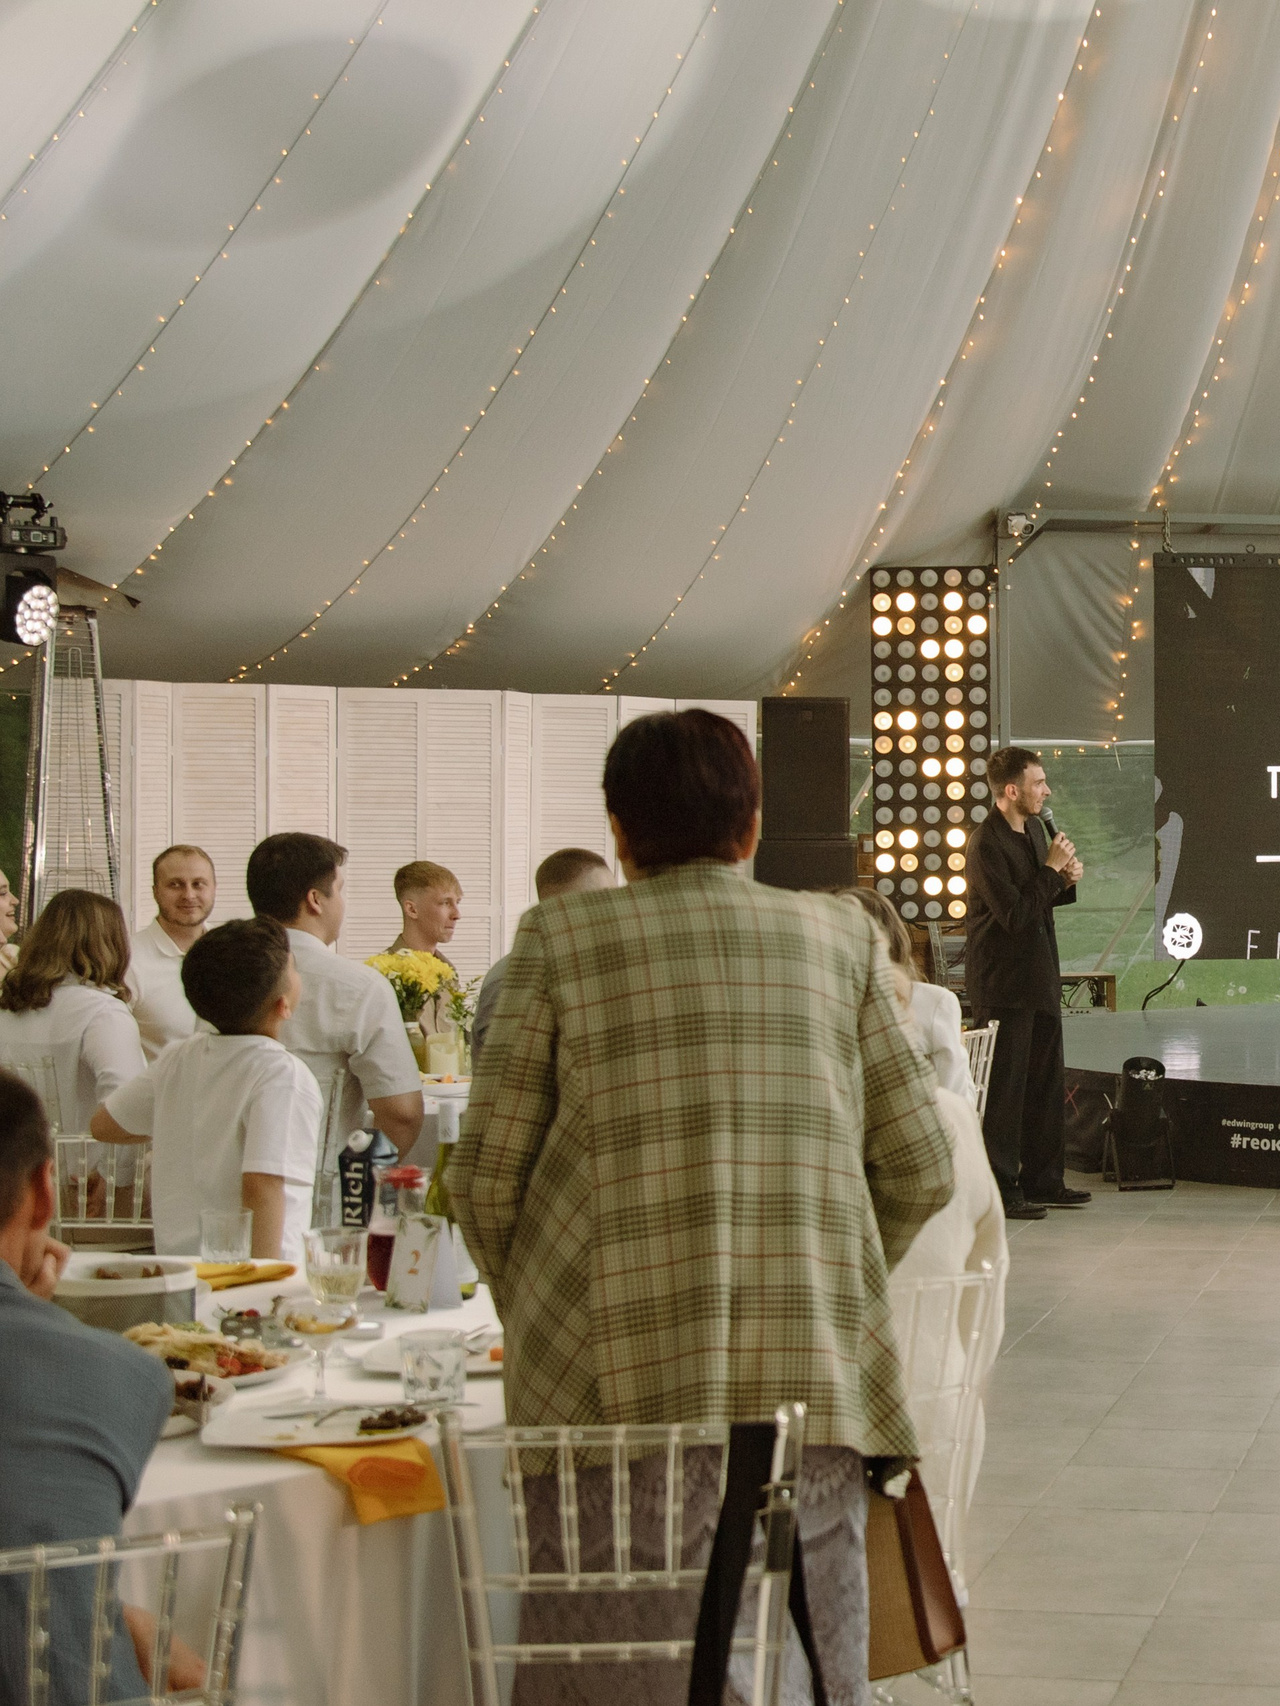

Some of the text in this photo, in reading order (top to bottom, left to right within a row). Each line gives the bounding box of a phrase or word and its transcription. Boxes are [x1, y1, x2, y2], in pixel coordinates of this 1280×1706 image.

[1221, 1118, 1275, 1132] #edwingroup
[343, 1161, 364, 1225] Rich
[407, 1248, 422, 1275] 2
